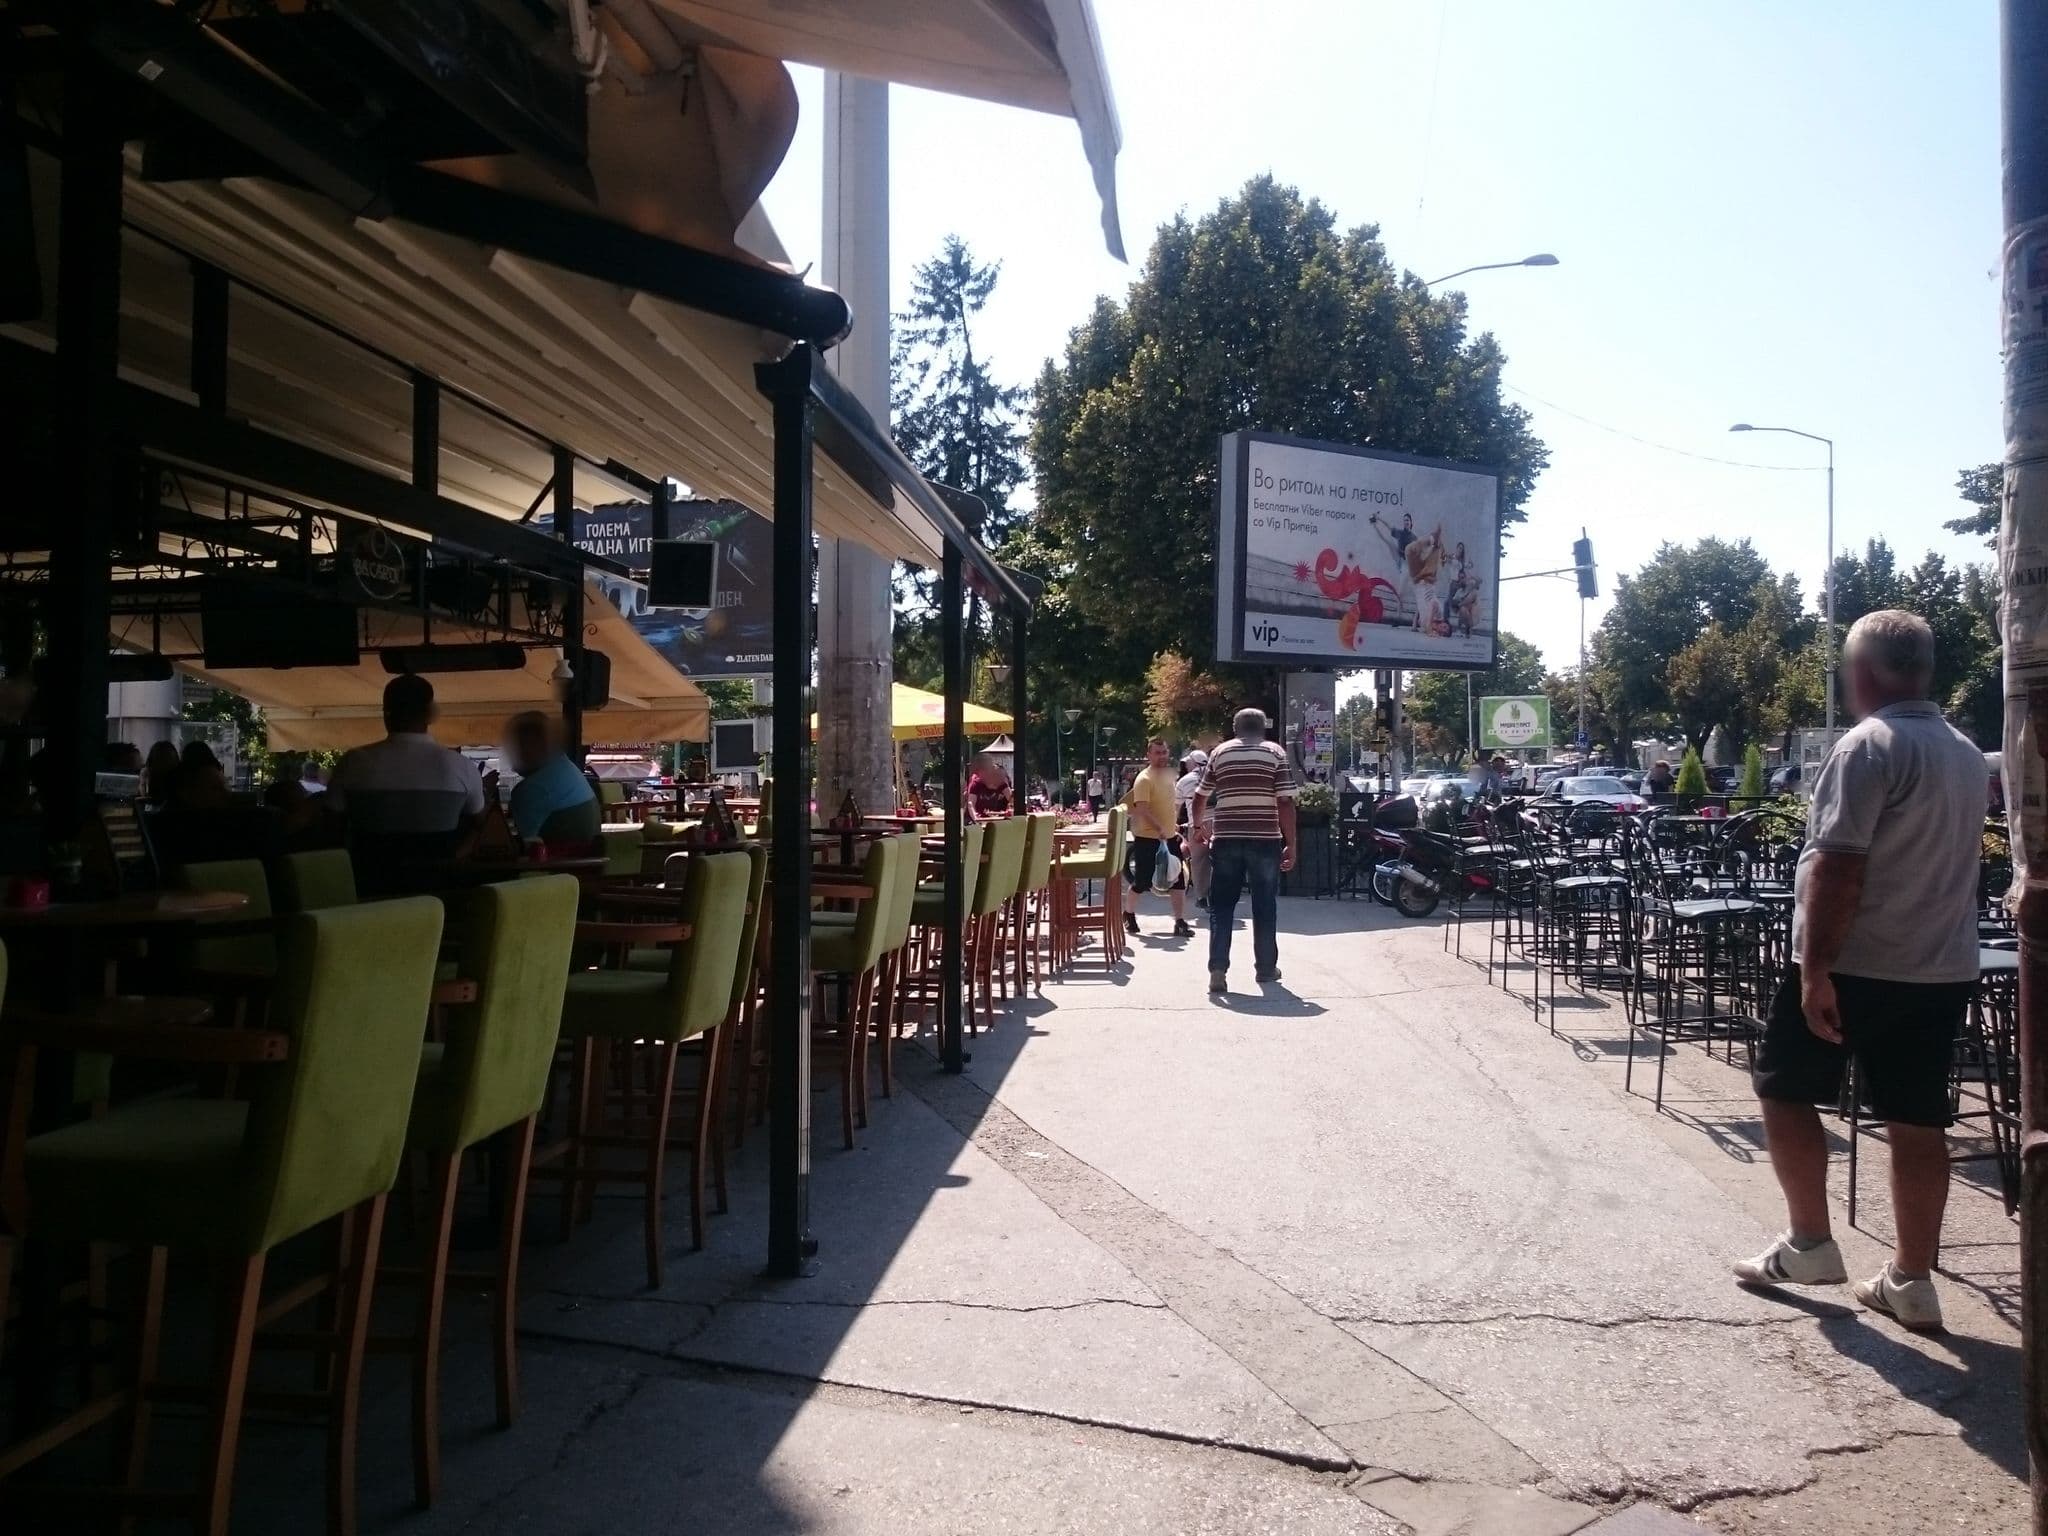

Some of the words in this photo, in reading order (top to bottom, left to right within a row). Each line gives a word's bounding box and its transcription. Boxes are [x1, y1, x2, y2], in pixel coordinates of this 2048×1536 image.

[1254, 467, 1274, 490] Во
[1279, 478, 1325, 496] ритам
[1329, 485, 1347, 499] на
[1351, 487, 1404, 506] летото!
[1253, 498, 1300, 513] Бесплатни
[1301, 504, 1322, 517] Viber
[586, 522, 631, 538] ГОЛЕМА
[1253, 518, 1264, 528] со
[1266, 517, 1281, 531] Vip
[573, 539, 624, 556] ГРАДНА
[629, 537, 653, 554] ИГР
[1252, 620, 1279, 647] vip
[736, 654, 760, 662] ZLATEN
[916, 722, 944, 737] Sinalc
[1578, 733, 1585, 742] P
